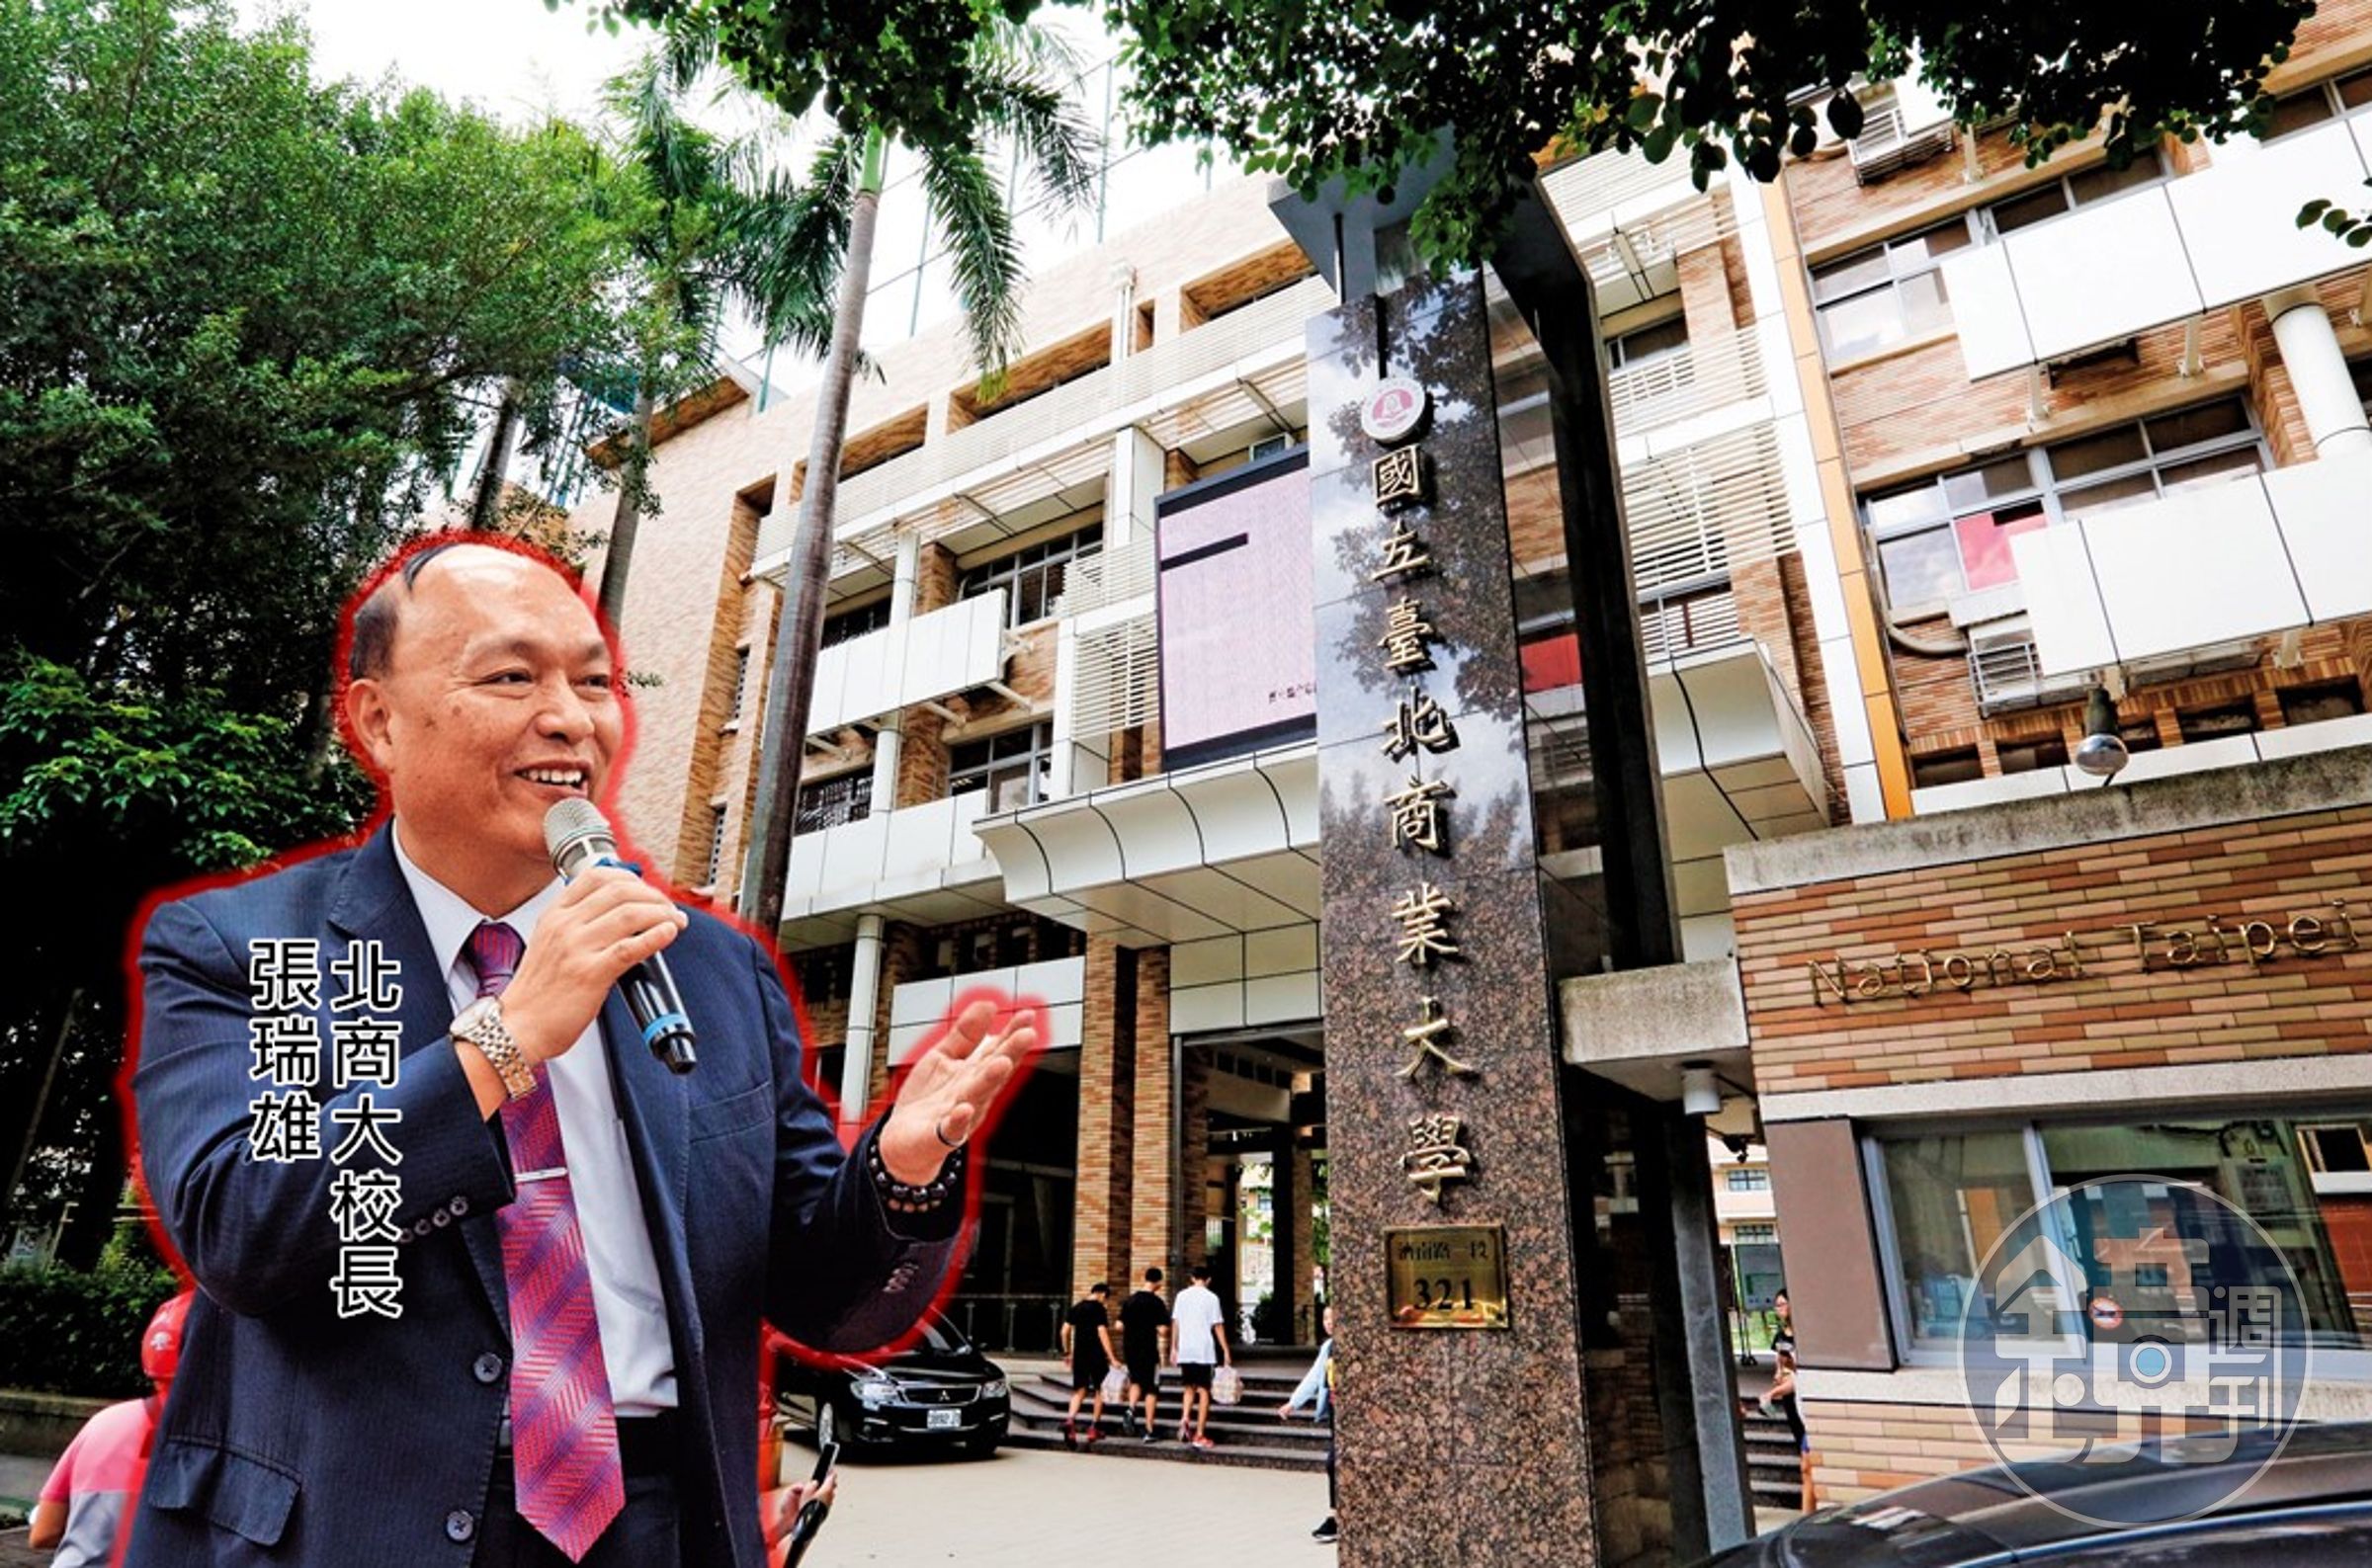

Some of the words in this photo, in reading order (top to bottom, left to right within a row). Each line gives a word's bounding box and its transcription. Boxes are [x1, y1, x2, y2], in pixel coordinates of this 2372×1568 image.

[1372, 444, 1472, 1203] 國立臺北商業大學
[1807, 930, 2084, 1007] National
[2117, 898, 2361, 973] Taipei
[1413, 1278, 1474, 1311] 321
